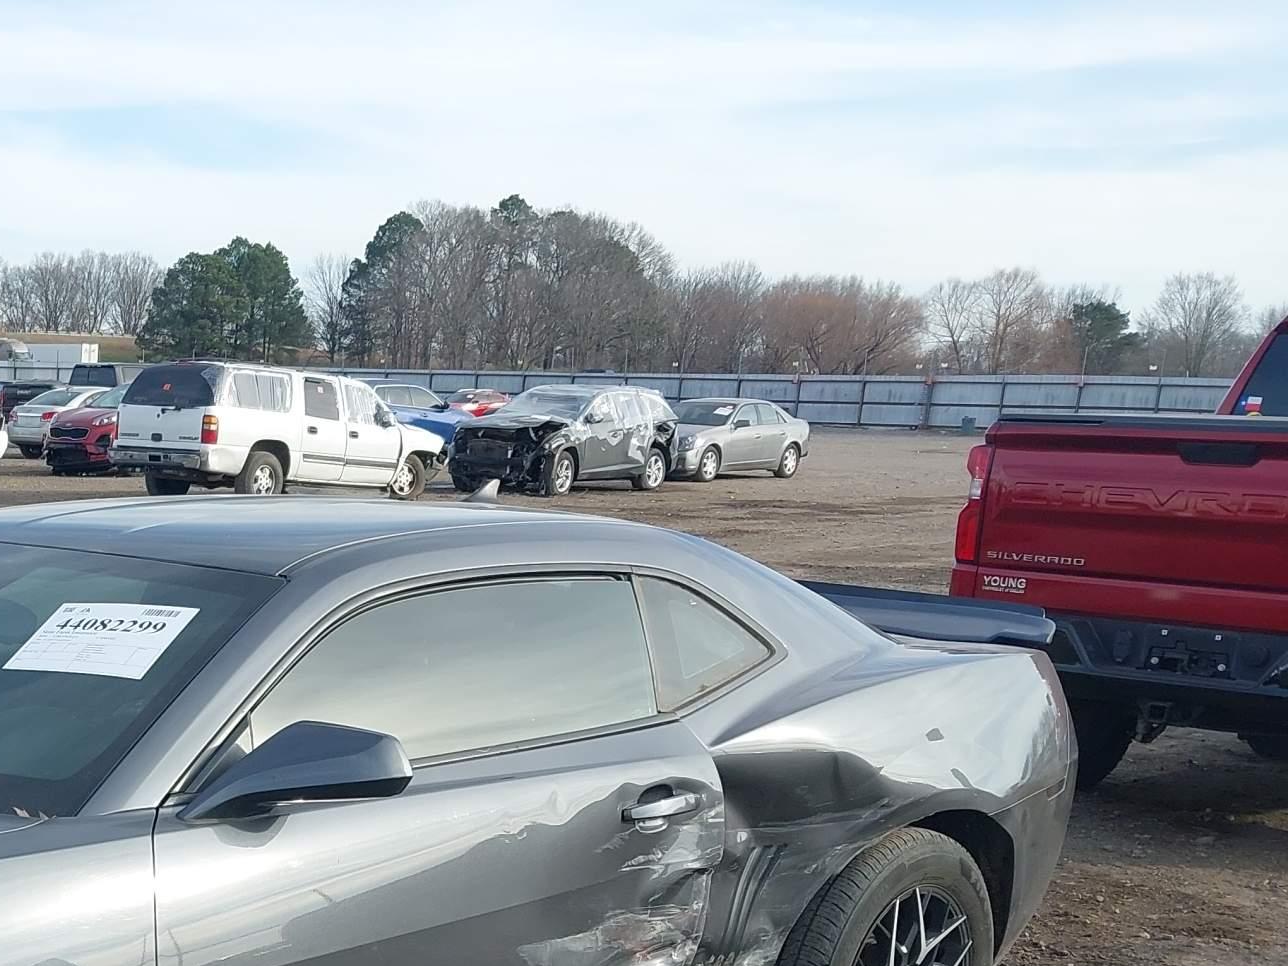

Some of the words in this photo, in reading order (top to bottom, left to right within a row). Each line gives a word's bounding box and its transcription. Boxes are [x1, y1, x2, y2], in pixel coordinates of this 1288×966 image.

[985, 550, 1086, 567] SILVERADO
[983, 575, 1027, 589] YOUNG
[56, 617, 166, 634] 44082299
